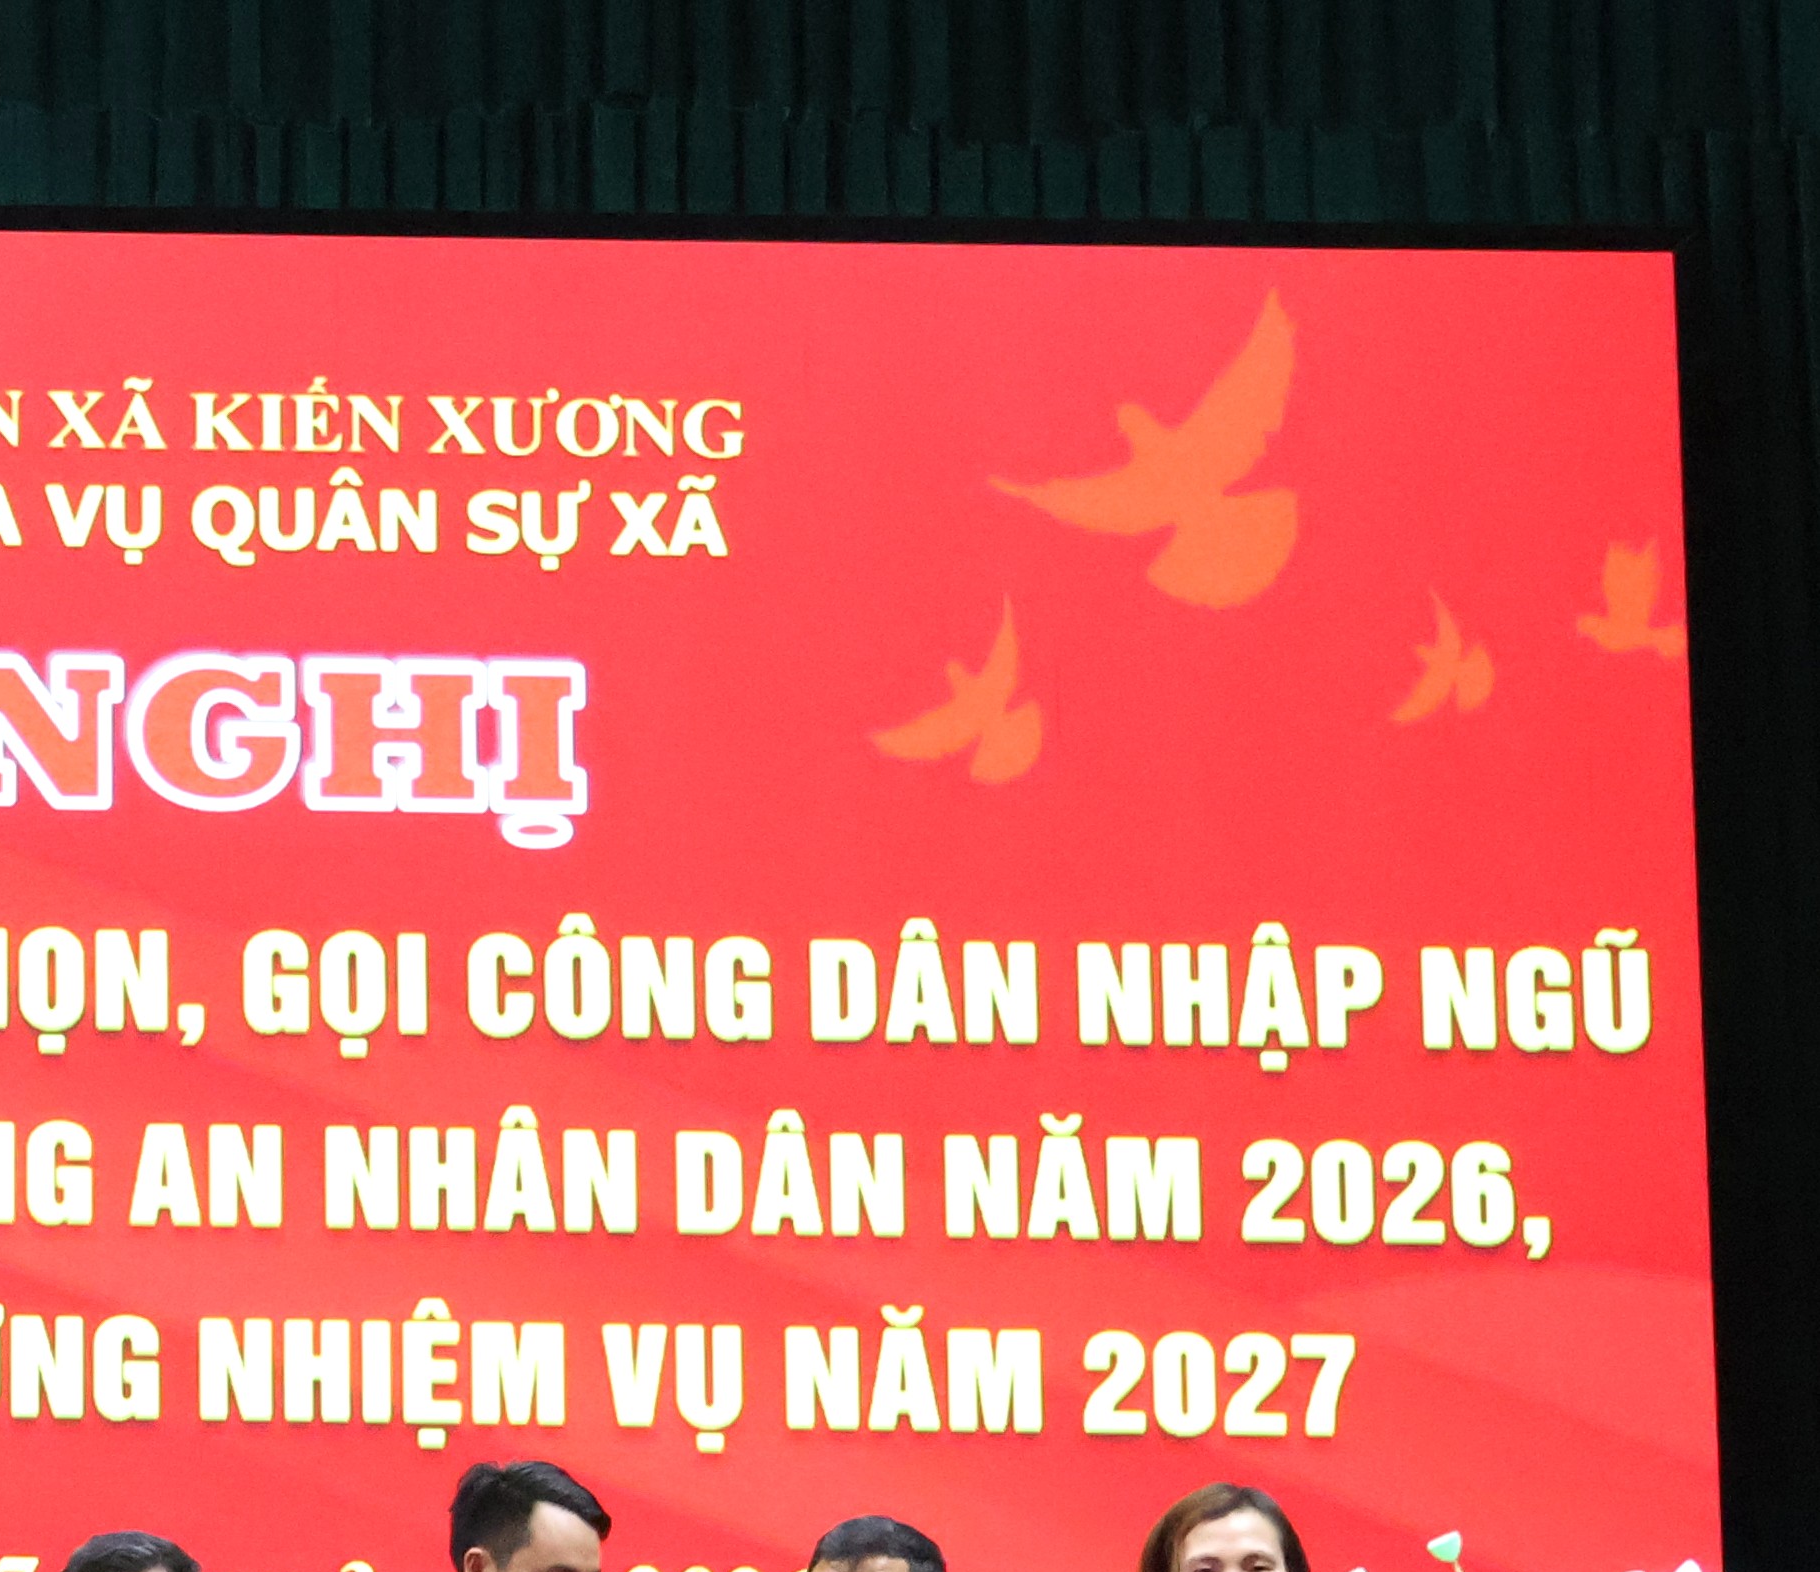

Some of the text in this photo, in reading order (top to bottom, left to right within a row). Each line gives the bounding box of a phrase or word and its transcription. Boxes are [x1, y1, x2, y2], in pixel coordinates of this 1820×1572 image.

[47, 374, 169, 452] XÃ
[189, 373, 405, 455] KIẾN
[427, 386, 747, 461] XƯƠNG
[44, 482, 164, 567] VỤ
[190, 466, 440, 568] QUÂN
[465, 478, 594, 573] SỰ
[609, 473, 731, 559] XÃ
[241, 934, 429, 1060] GỌI
[466, 912, 774, 1043] CÔNG
[808, 917, 1040, 1045] DÂN
[1076, 921, 1385, 1072] NHẬP
[1419, 928, 1652, 1054] NGŨ
[127, 1126, 285, 1230] AN
[323, 1104, 640, 1234] NHÂN
[674, 1108, 906, 1239] DÂN
[943, 1112, 1203, 1242] NĂM
[1240, 1144, 1552, 1260] 2026,
[197, 1296, 568, 1449] NHIỆM
[600, 1327, 745, 1455] VỤ
[783, 1304, 1044, 1434] NĂM
[1082, 1333, 1357, 1438] 2027
